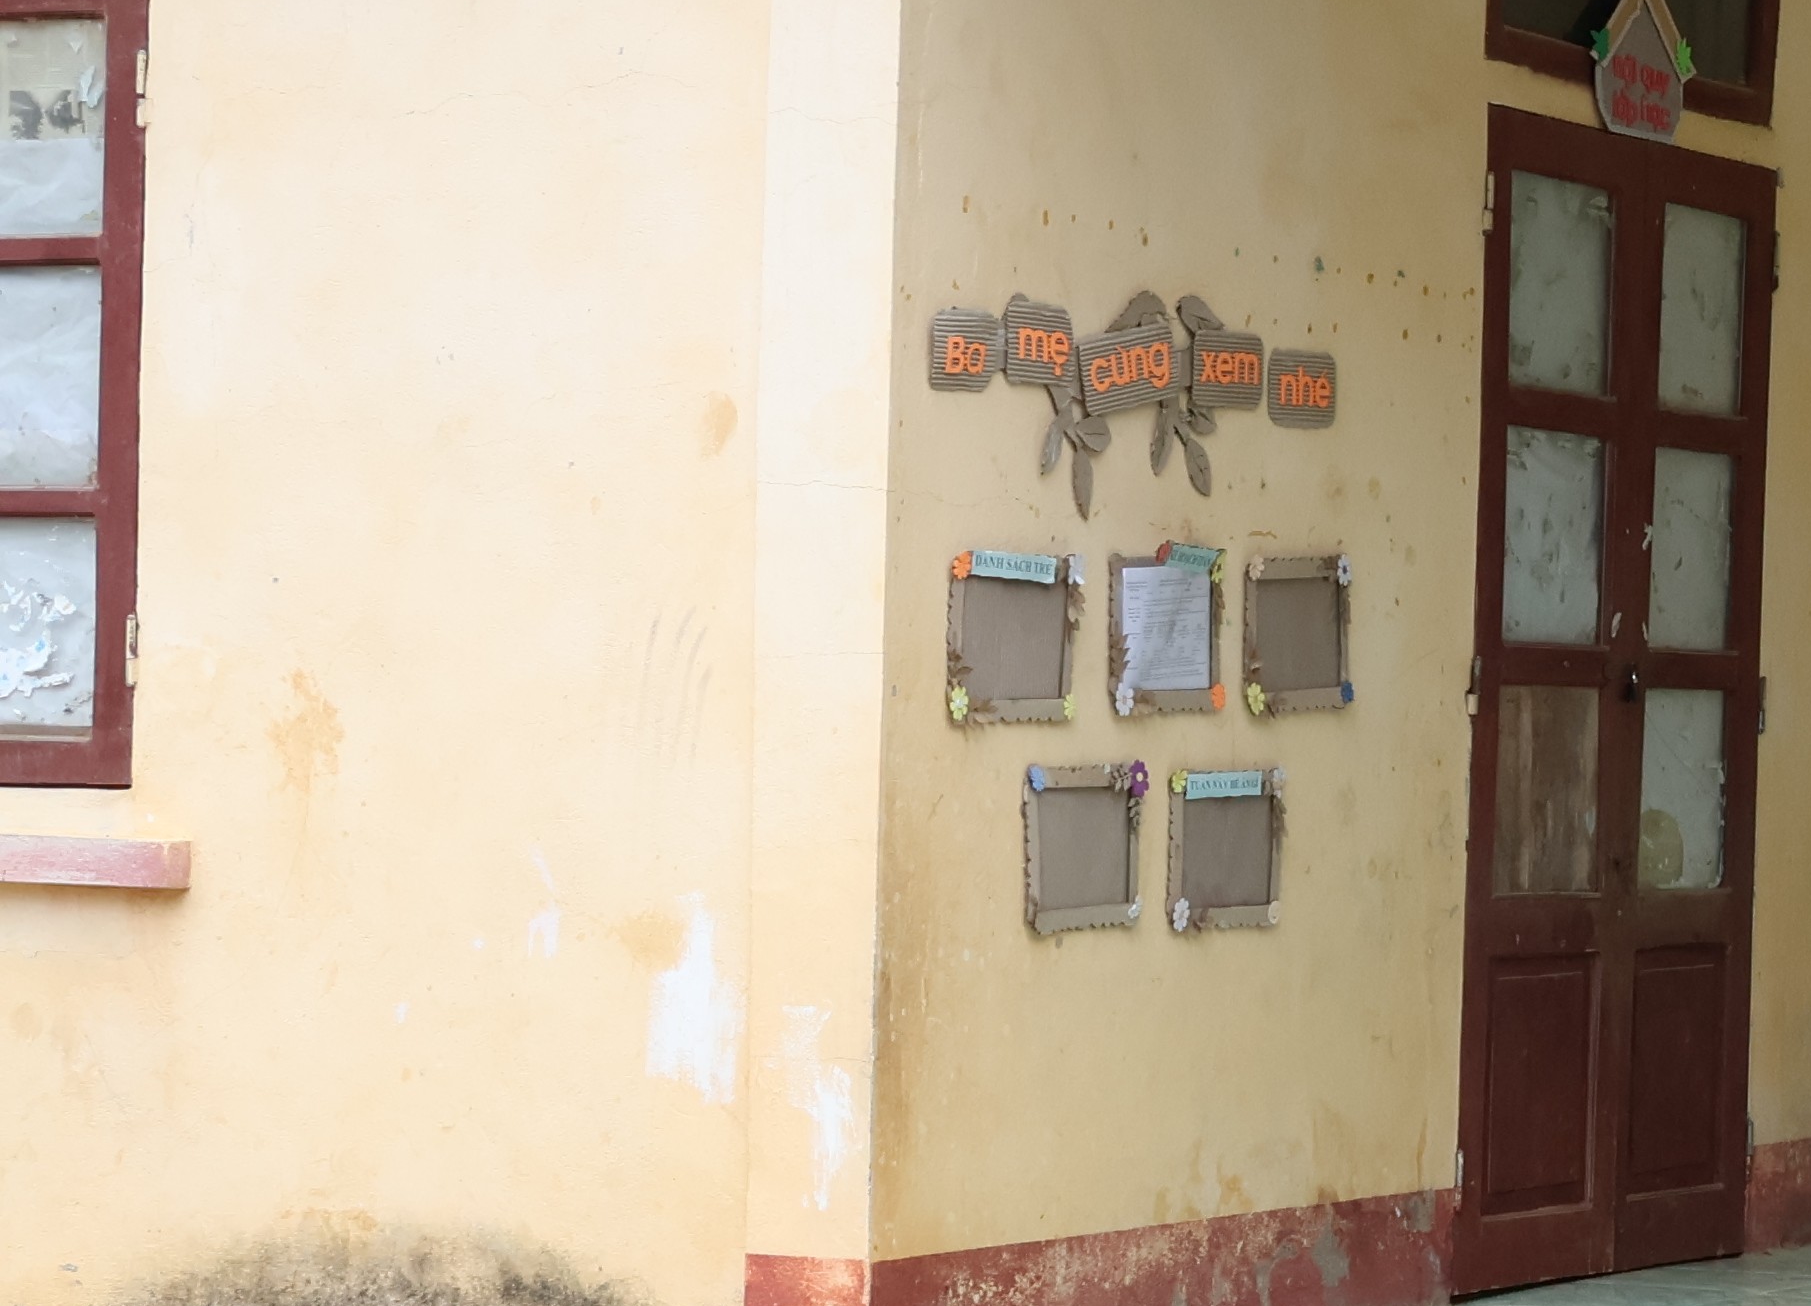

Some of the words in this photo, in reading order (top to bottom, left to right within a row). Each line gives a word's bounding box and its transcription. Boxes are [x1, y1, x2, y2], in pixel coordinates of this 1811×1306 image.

[945, 336, 988, 375] Ba
[1018, 326, 1071, 376] mẹ
[1090, 342, 1171, 392] cùng
[1201, 351, 1260, 385] xem
[1279, 366, 1332, 408] nhé
[975, 554, 1004, 569] DANH
